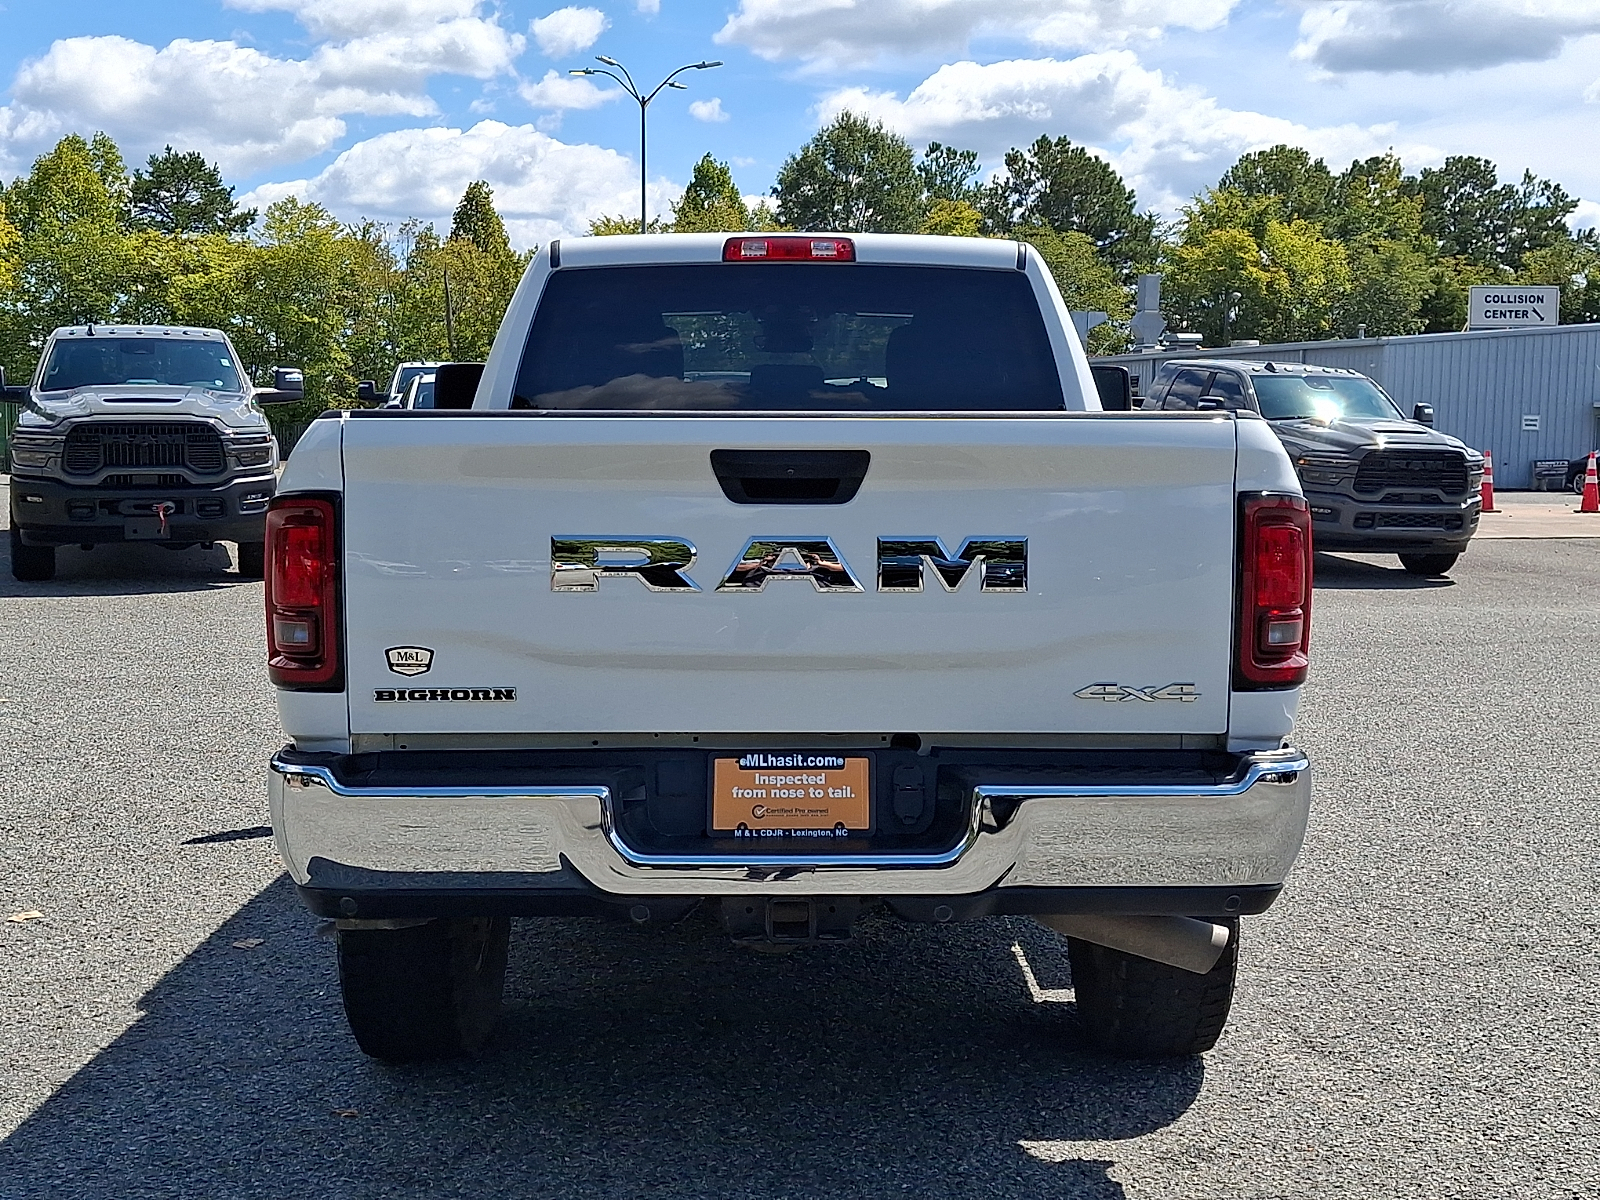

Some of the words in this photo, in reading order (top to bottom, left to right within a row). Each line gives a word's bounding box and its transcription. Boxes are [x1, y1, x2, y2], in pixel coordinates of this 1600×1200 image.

[1484, 294, 1545, 304] COLLISION
[1484, 309, 1529, 319] CENTER
[551, 535, 1029, 592] RAM
[396, 651, 424, 662] M&L
[374, 687, 517, 703] BIGHORN
[746, 754, 837, 767] MLhasit.com
[755, 772, 826, 787] Inspected
[732, 786, 767, 798] from
[770, 788, 805, 798] nose
[808, 787, 824, 798] to
[827, 786, 855, 798] tail.
[734, 829, 742, 837] M
[744, 829, 751, 837] &
[752, 829, 758, 837] L
[760, 829, 784, 837] CDJR
[791, 829, 834, 838] Lexington,
[836, 829, 849, 837] NC
